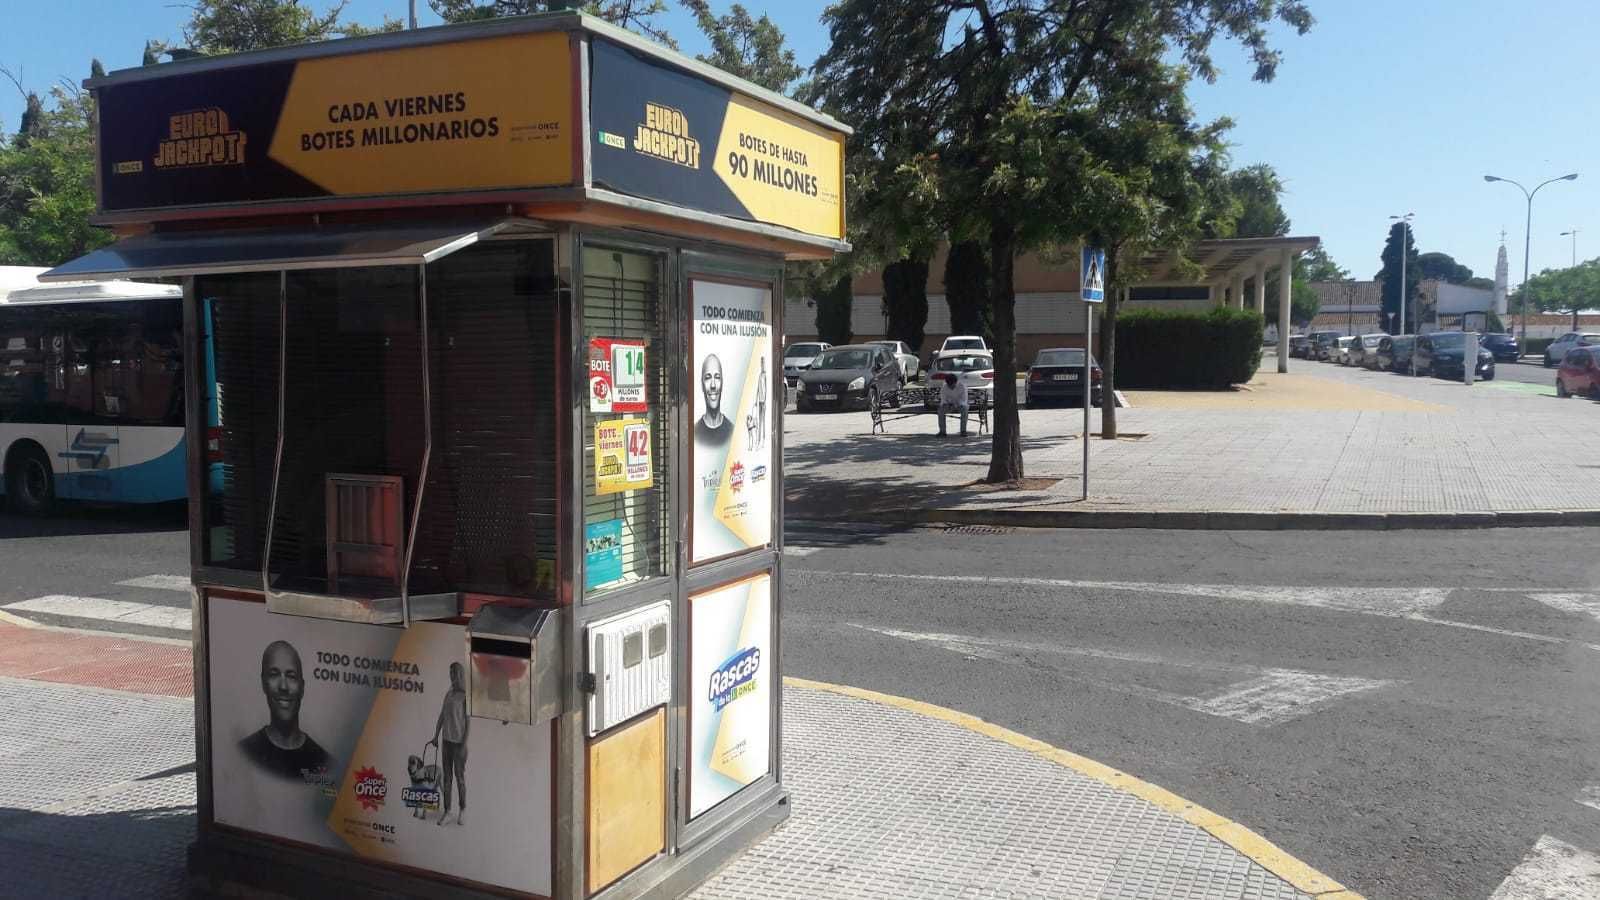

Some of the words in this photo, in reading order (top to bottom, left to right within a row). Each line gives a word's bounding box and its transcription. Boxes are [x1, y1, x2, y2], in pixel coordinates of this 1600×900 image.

[328, 102, 379, 123] CADA
[385, 92, 466, 117] VIERNES
[646, 102, 688, 137] EURO
[168, 108, 228, 139] EURO
[301, 130, 355, 151] BOTES
[362, 117, 499, 146] MILLONARIOS
[154, 133, 245, 167] JACKPOT
[605, 136, 625, 148] ONCE
[633, 126, 700, 169] JACKPOT
[739, 133, 767, 155] BOTES
[769, 143, 780, 159] DE
[782, 147, 808, 168] HASTA
[729, 152, 749, 179] 90
[753, 158, 819, 198] MILLONES
[702, 305, 726, 319] TODO
[727, 307, 766, 322] COMIENZA
[700, 322, 719, 335] CON
[721, 323, 738, 336] UNA
[739, 323, 768, 337] ILUSIÓN
[591, 359, 611, 372] BOTE
[625, 350, 644, 376] 14
[598, 428, 617, 439] BOTE
[629, 430, 649, 457] 42
[317, 652, 350, 667] TODO
[354, 656, 420, 676] COMIENZA
[709, 648, 760, 702] Rascas
[313, 668, 340, 683] CON
[343, 672, 370, 687] UNA
[372, 675, 425, 694] ILUSIÓN
[355, 782, 387, 796] Once
[401, 788, 440, 802] Rascas
[372, 822, 396, 834] ONCE
